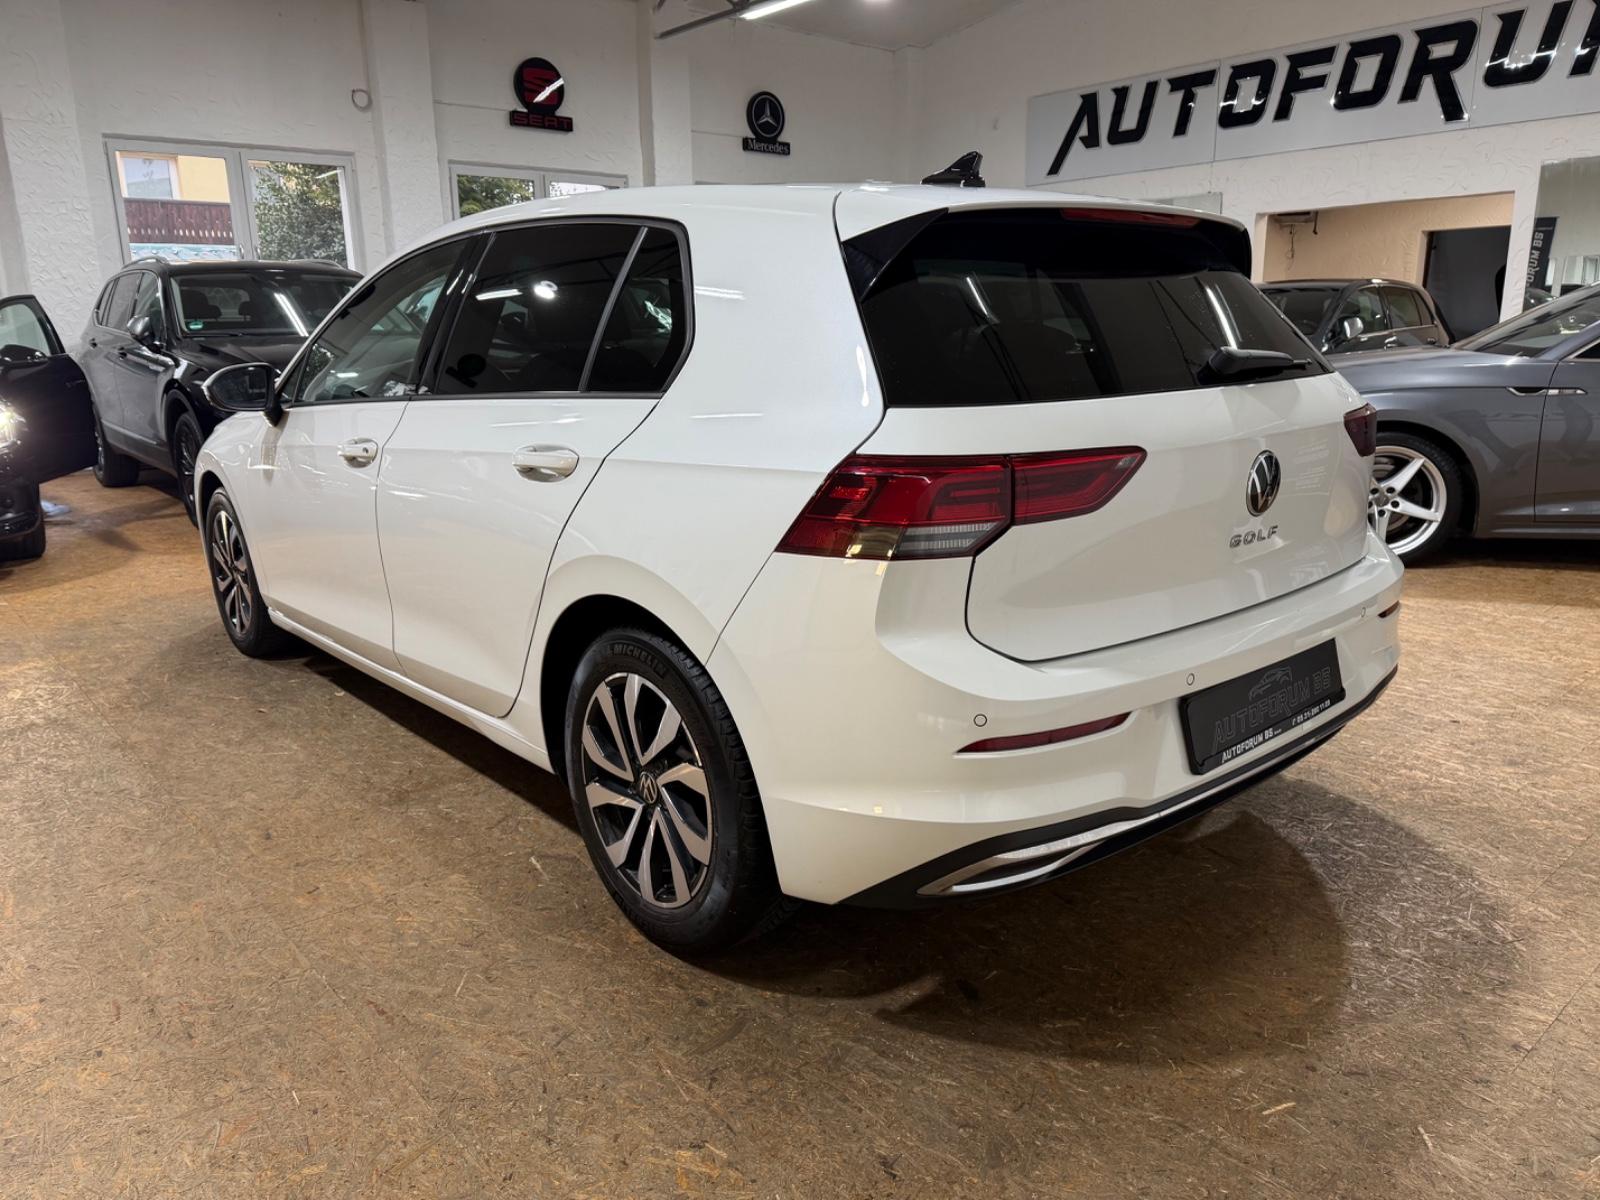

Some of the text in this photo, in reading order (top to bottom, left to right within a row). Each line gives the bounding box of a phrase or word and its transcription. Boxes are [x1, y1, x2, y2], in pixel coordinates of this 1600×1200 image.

[513, 112, 572, 130] SEAT
[747, 138, 790, 154] Mercedes
[1229, 525, 1278, 548] GOLF
[1213, 676, 1310, 752] AUTOFORUM
[1221, 734, 1264, 763] AUTOFORUM
